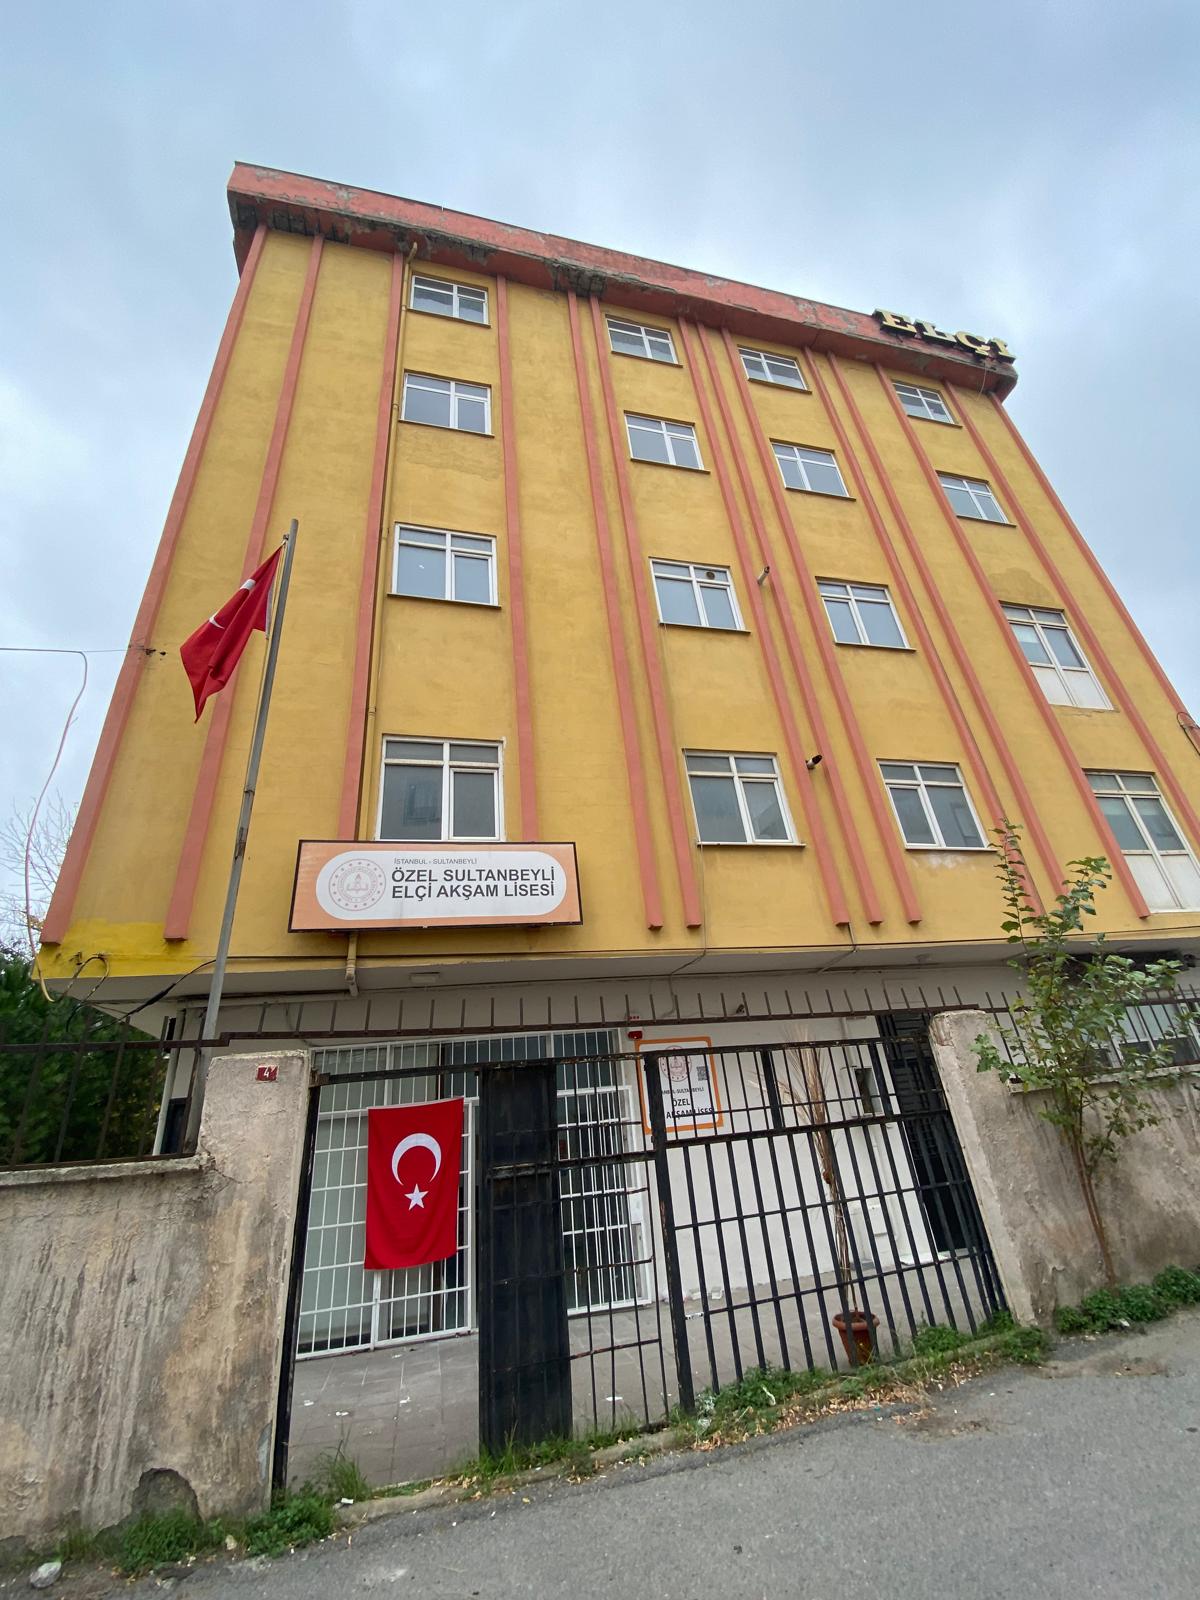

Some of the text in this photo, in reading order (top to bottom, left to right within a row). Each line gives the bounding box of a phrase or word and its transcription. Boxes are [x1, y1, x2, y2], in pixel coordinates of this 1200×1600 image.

[393, 857, 428, 865] İSTANBUL
[432, 857, 478, 865] SULTANBEYLİ
[391, 866, 555, 882] ÖZEL SULTANBEYLİ
[391, 882, 432, 902] ELÇİ
[436, 884, 499, 901] AKŞAM
[504, 881, 555, 897] LİSESİ
